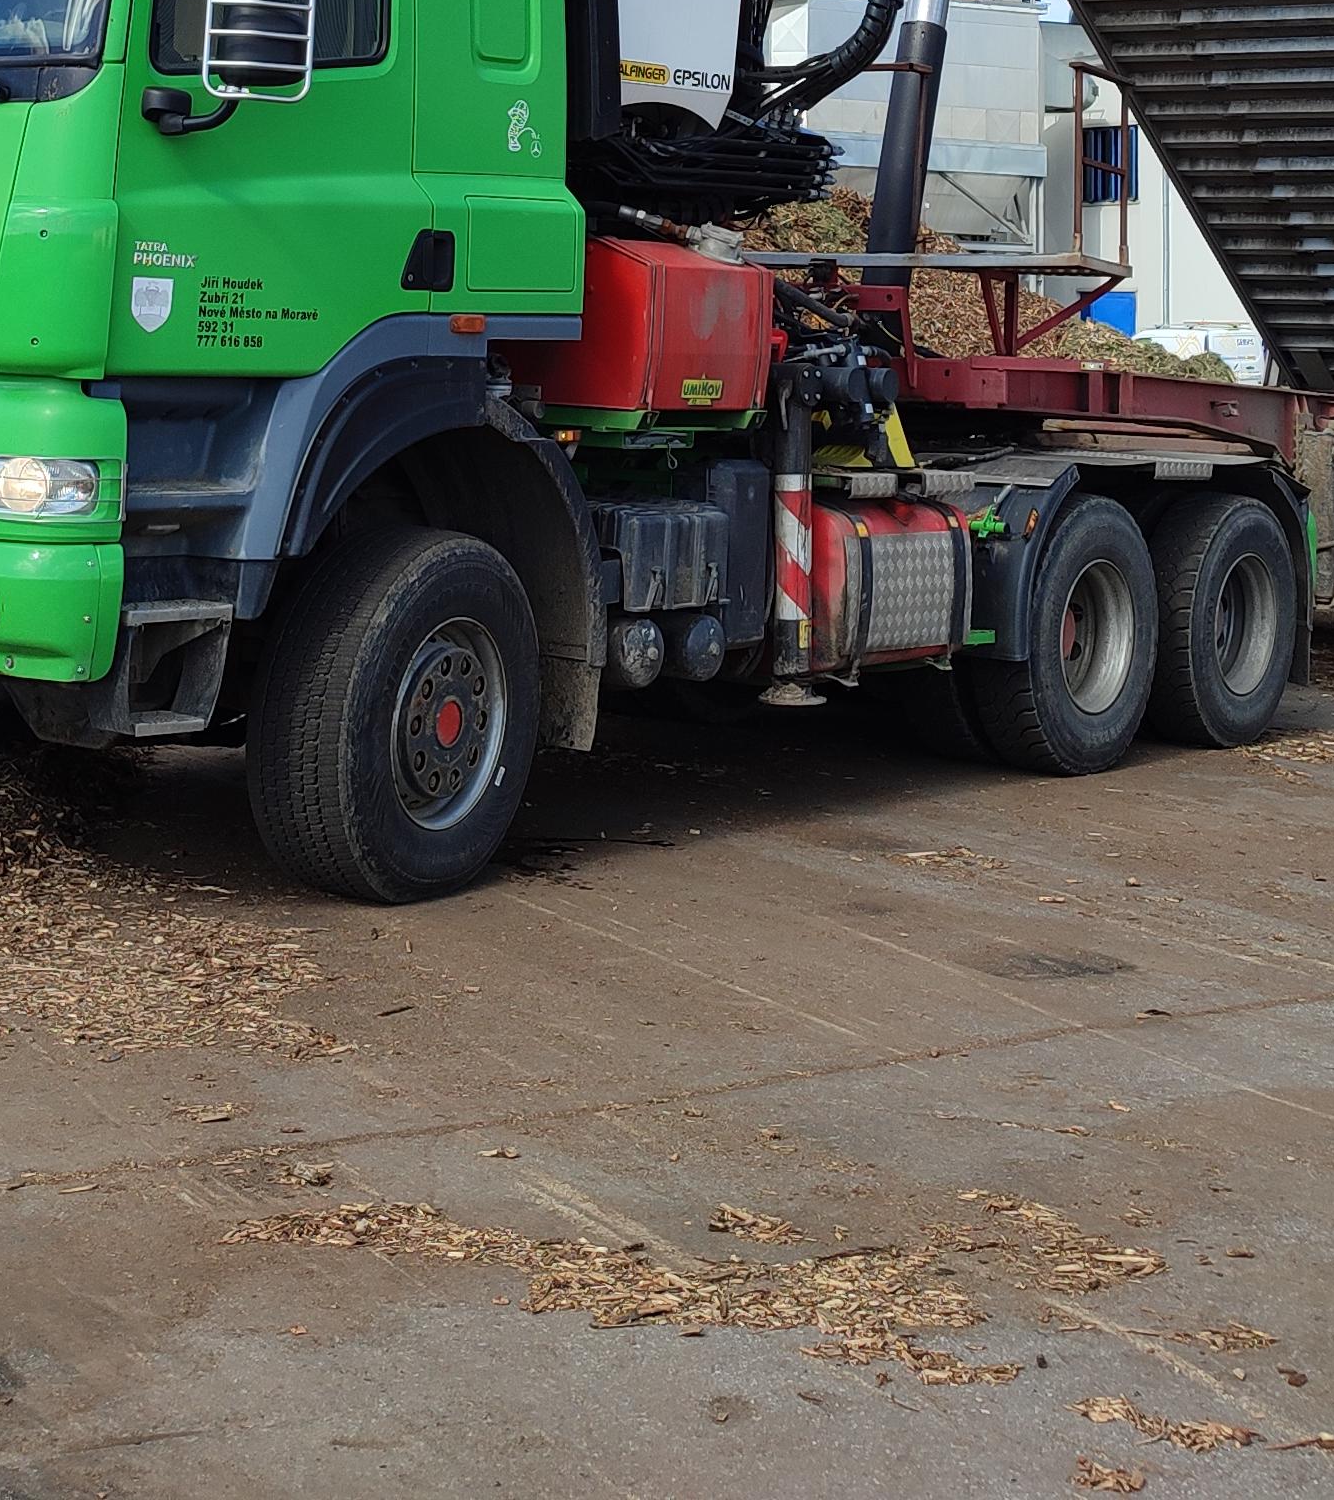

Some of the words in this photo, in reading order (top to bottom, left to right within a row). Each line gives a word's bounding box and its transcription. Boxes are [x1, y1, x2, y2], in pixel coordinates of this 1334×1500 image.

[619, 64, 666, 81] ALFINGER
[673, 68, 731, 90] EPSILON
[134, 240, 168, 252] TATRA
[133, 251, 196, 268] PHOENIX
[222, 276, 264, 290] Houdek
[231, 292, 245, 305] 21
[198, 305, 227, 318] Nové
[265, 310, 278, 320] na
[197, 320, 219, 333] 592
[221, 320, 235, 334] 31
[196, 334, 218, 348] 777
[220, 334, 241, 348] 616
